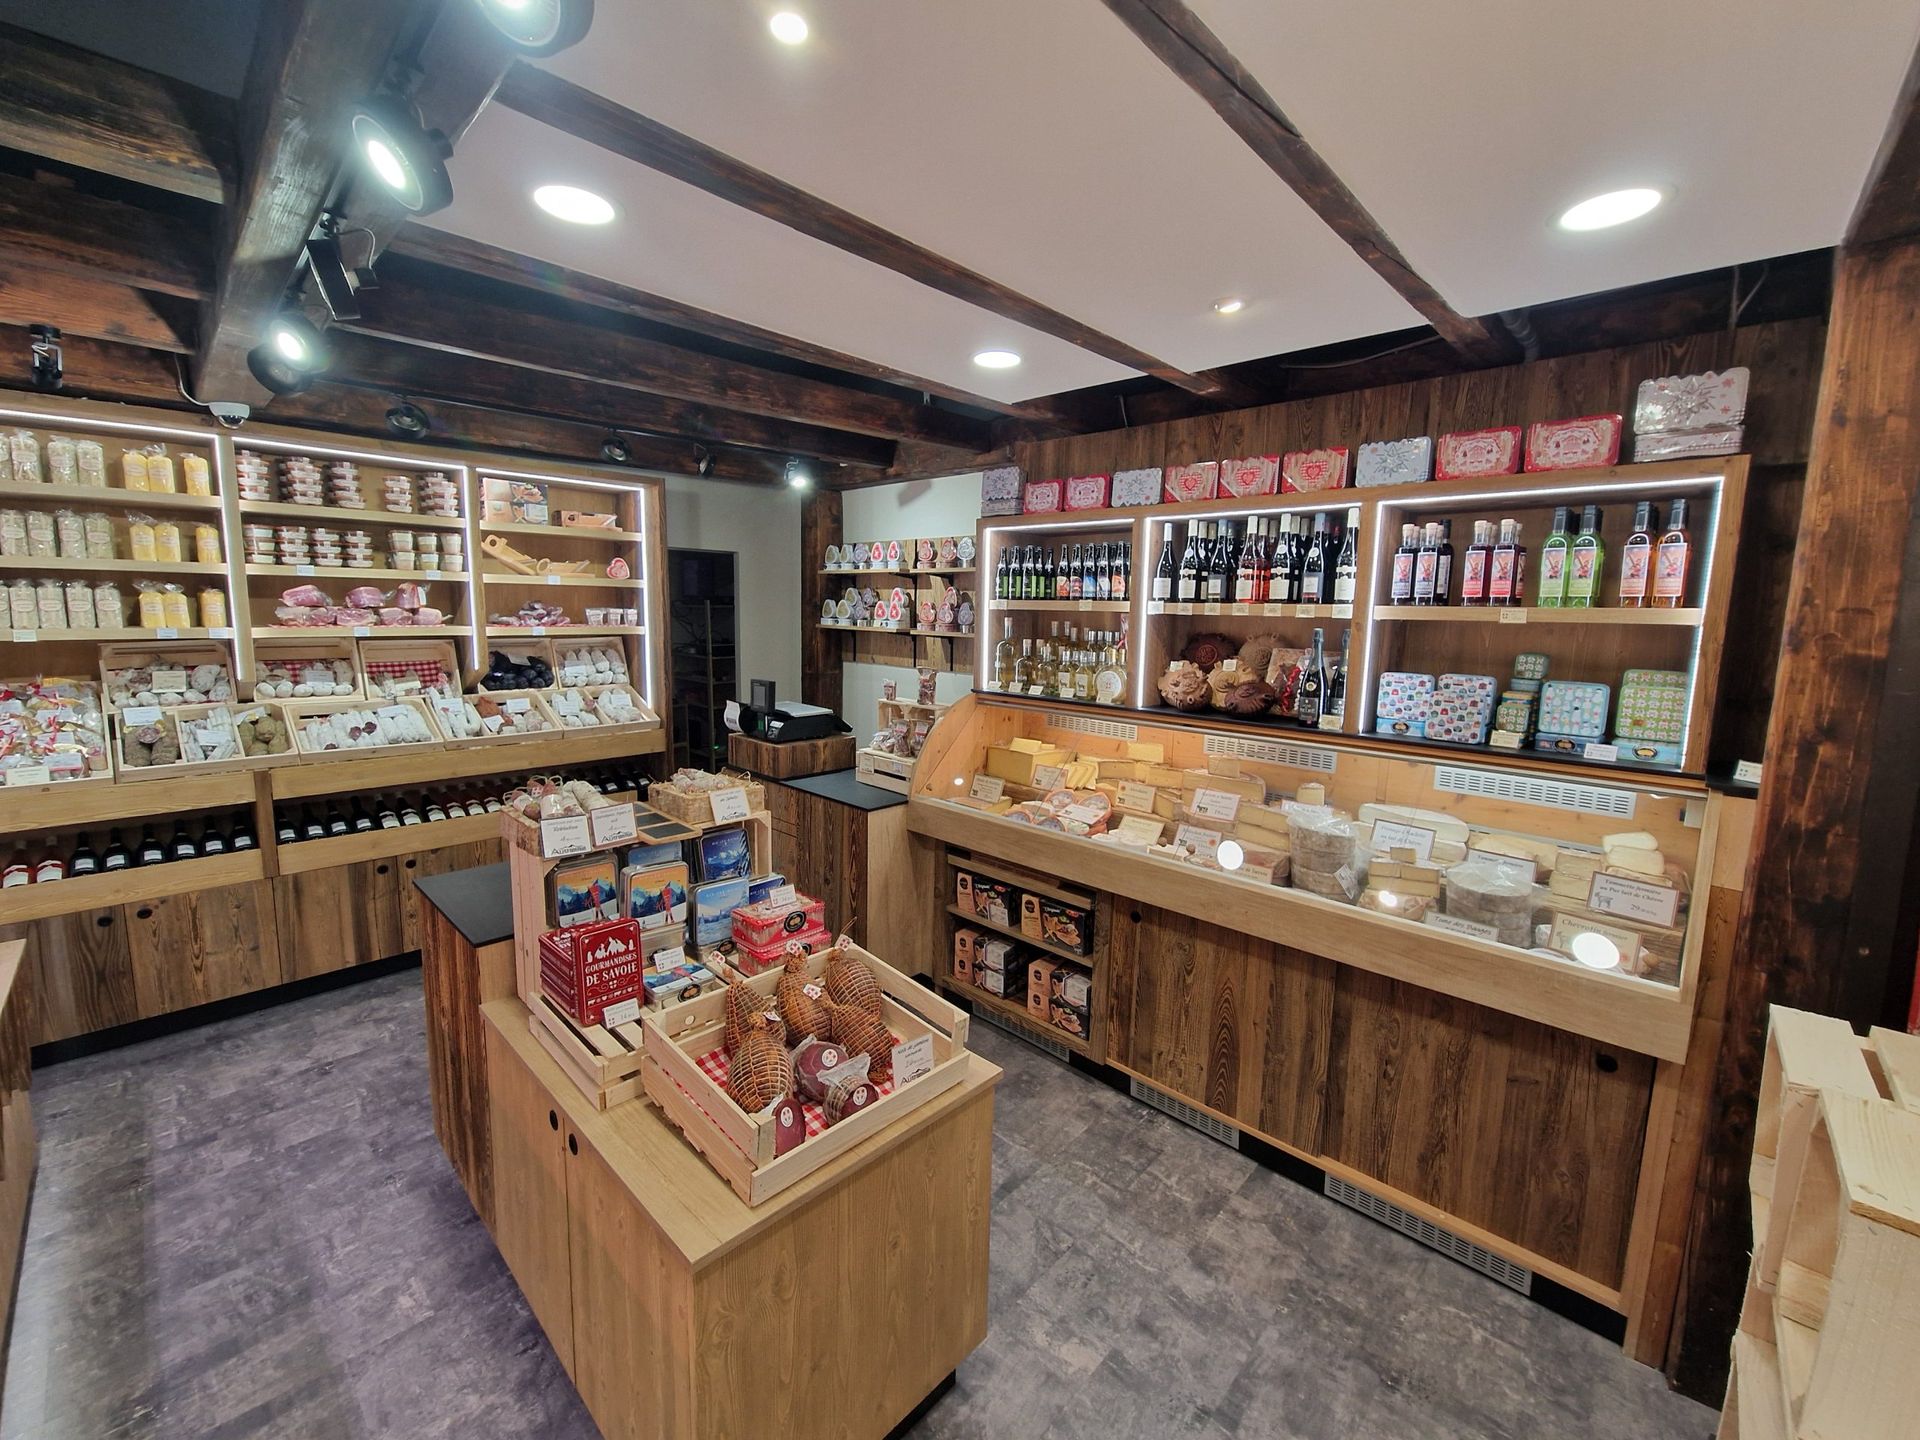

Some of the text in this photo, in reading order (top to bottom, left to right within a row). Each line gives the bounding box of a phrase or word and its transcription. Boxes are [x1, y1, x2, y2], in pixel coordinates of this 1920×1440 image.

[585, 952, 638, 974] GOURMANDISES
[586, 962, 638, 987] DE SAVOIE
